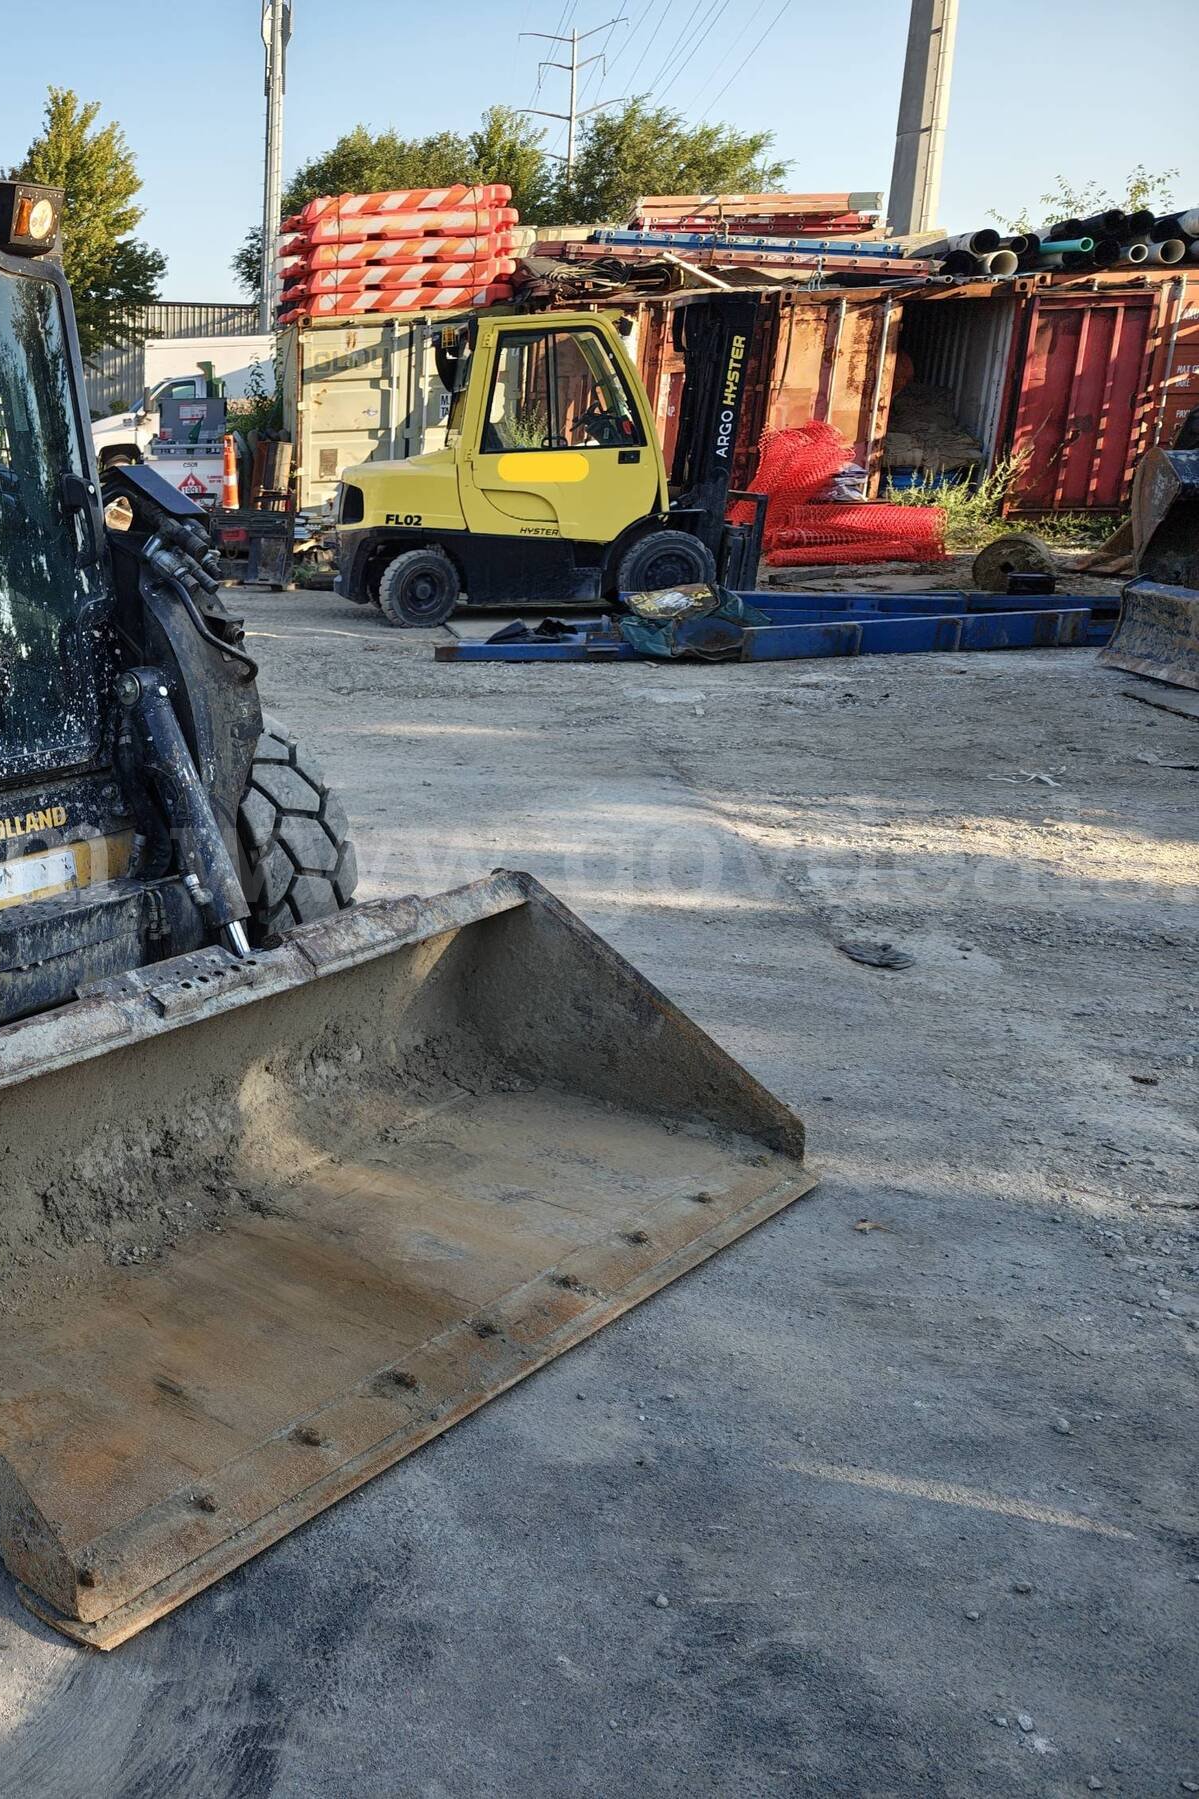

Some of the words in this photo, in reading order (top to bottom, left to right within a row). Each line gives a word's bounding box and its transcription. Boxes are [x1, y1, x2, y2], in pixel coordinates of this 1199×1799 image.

[722, 335, 747, 406] HYSTER
[715, 410, 734, 458] ARGO
[385, 514, 423, 527] FL02
[519, 527, 560, 537] HYSTER
